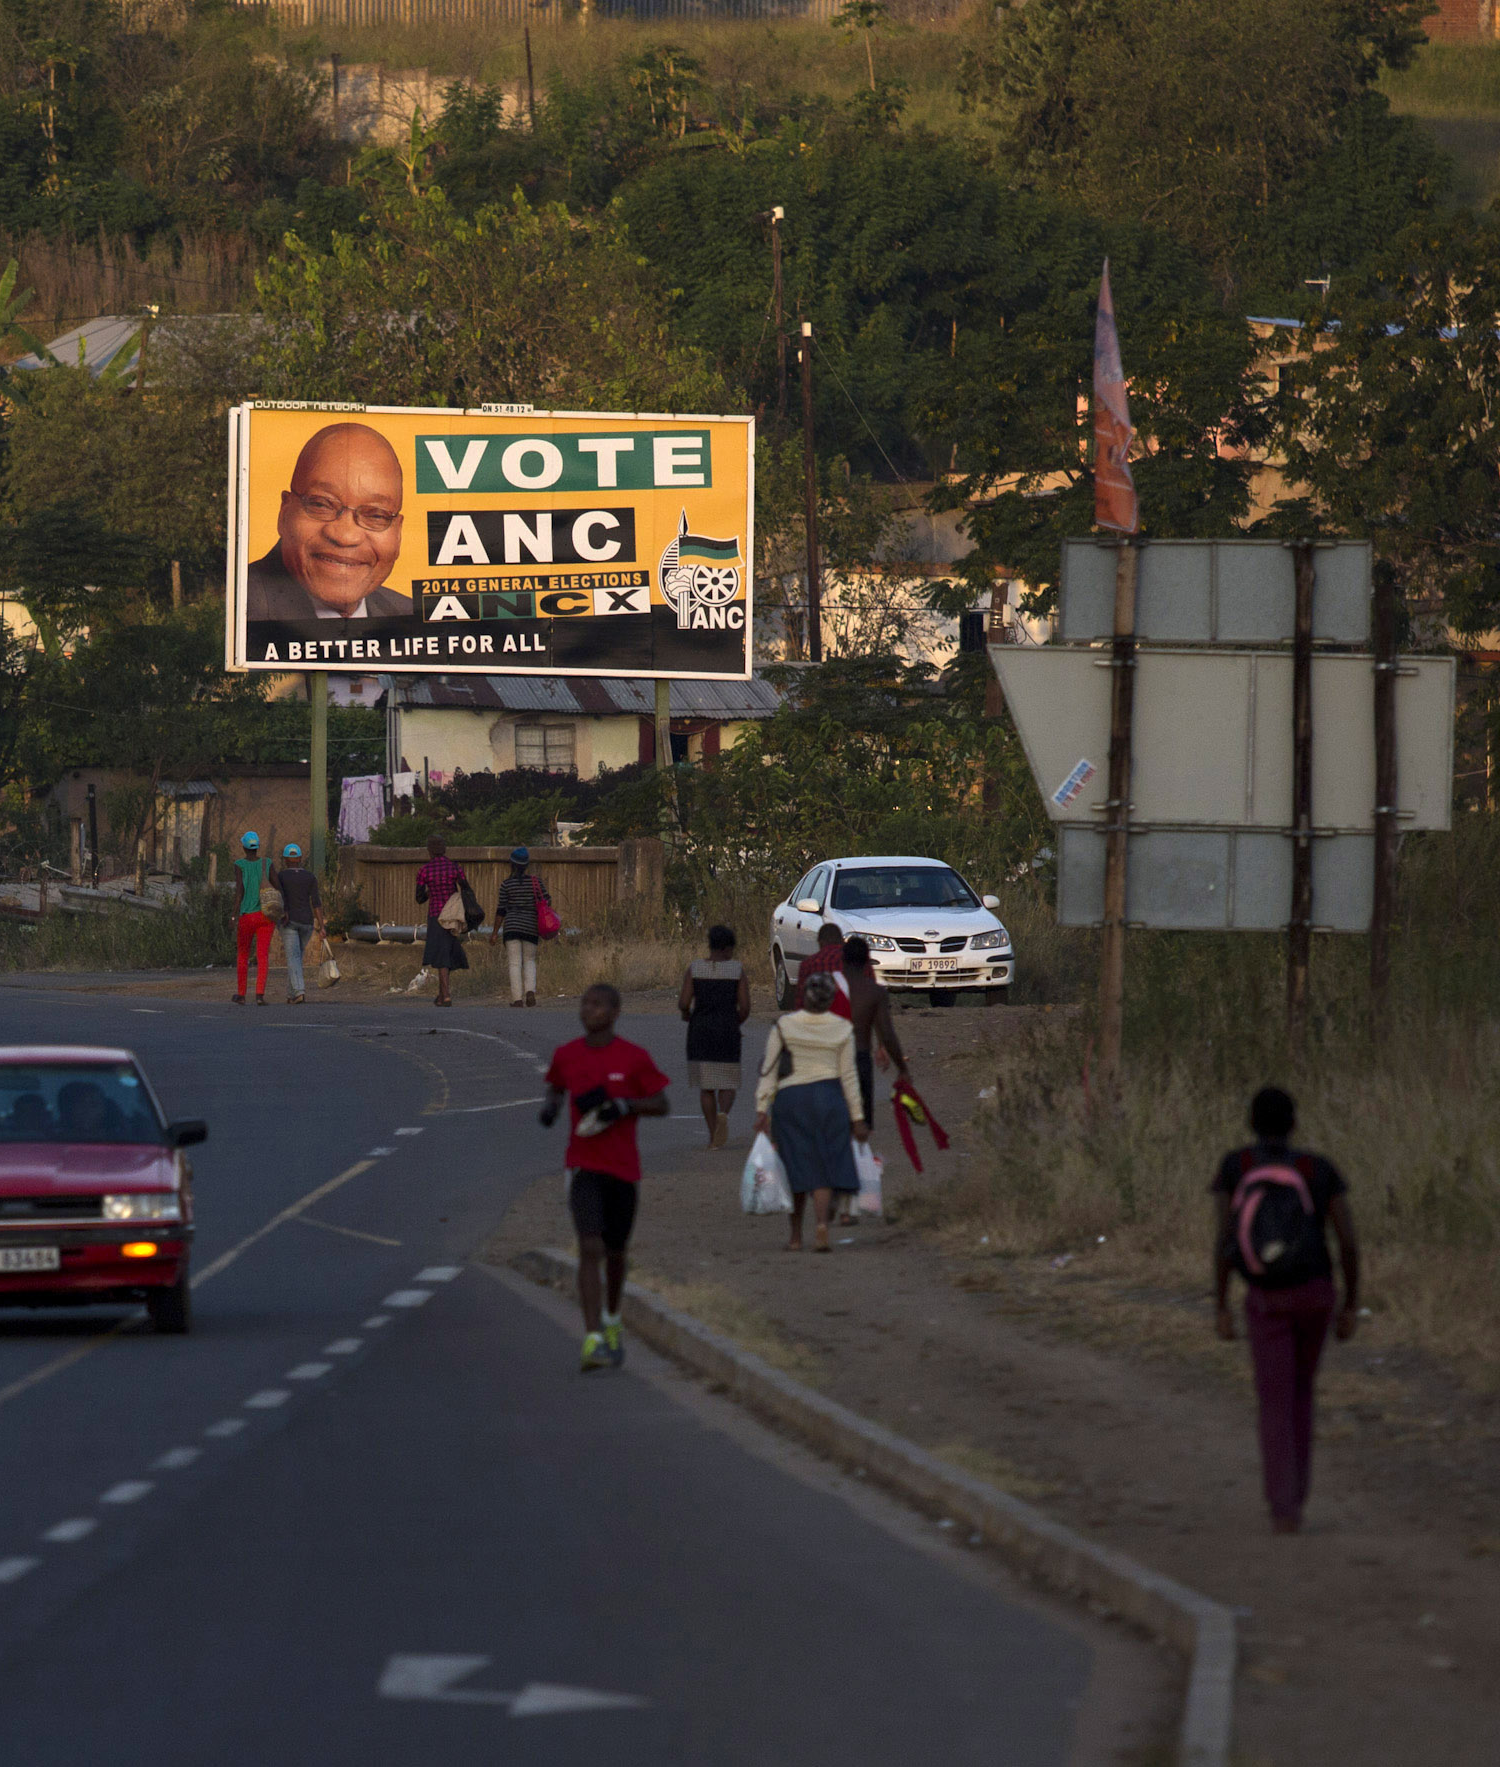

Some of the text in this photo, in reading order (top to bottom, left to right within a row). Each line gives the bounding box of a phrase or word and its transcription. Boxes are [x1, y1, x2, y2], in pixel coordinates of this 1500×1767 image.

[255, 400, 307, 410] OUTDOOR
[424, 436, 706, 490] VOTE
[435, 510, 622, 565] ANC
[421, 570, 642, 594] 2014 GENERAL ELECTIONS
[692, 606, 744, 630] ANC
[265, 632, 546, 661] A BETTER LIFE FOR ALL
[912, 960, 955, 970] NP 19892
